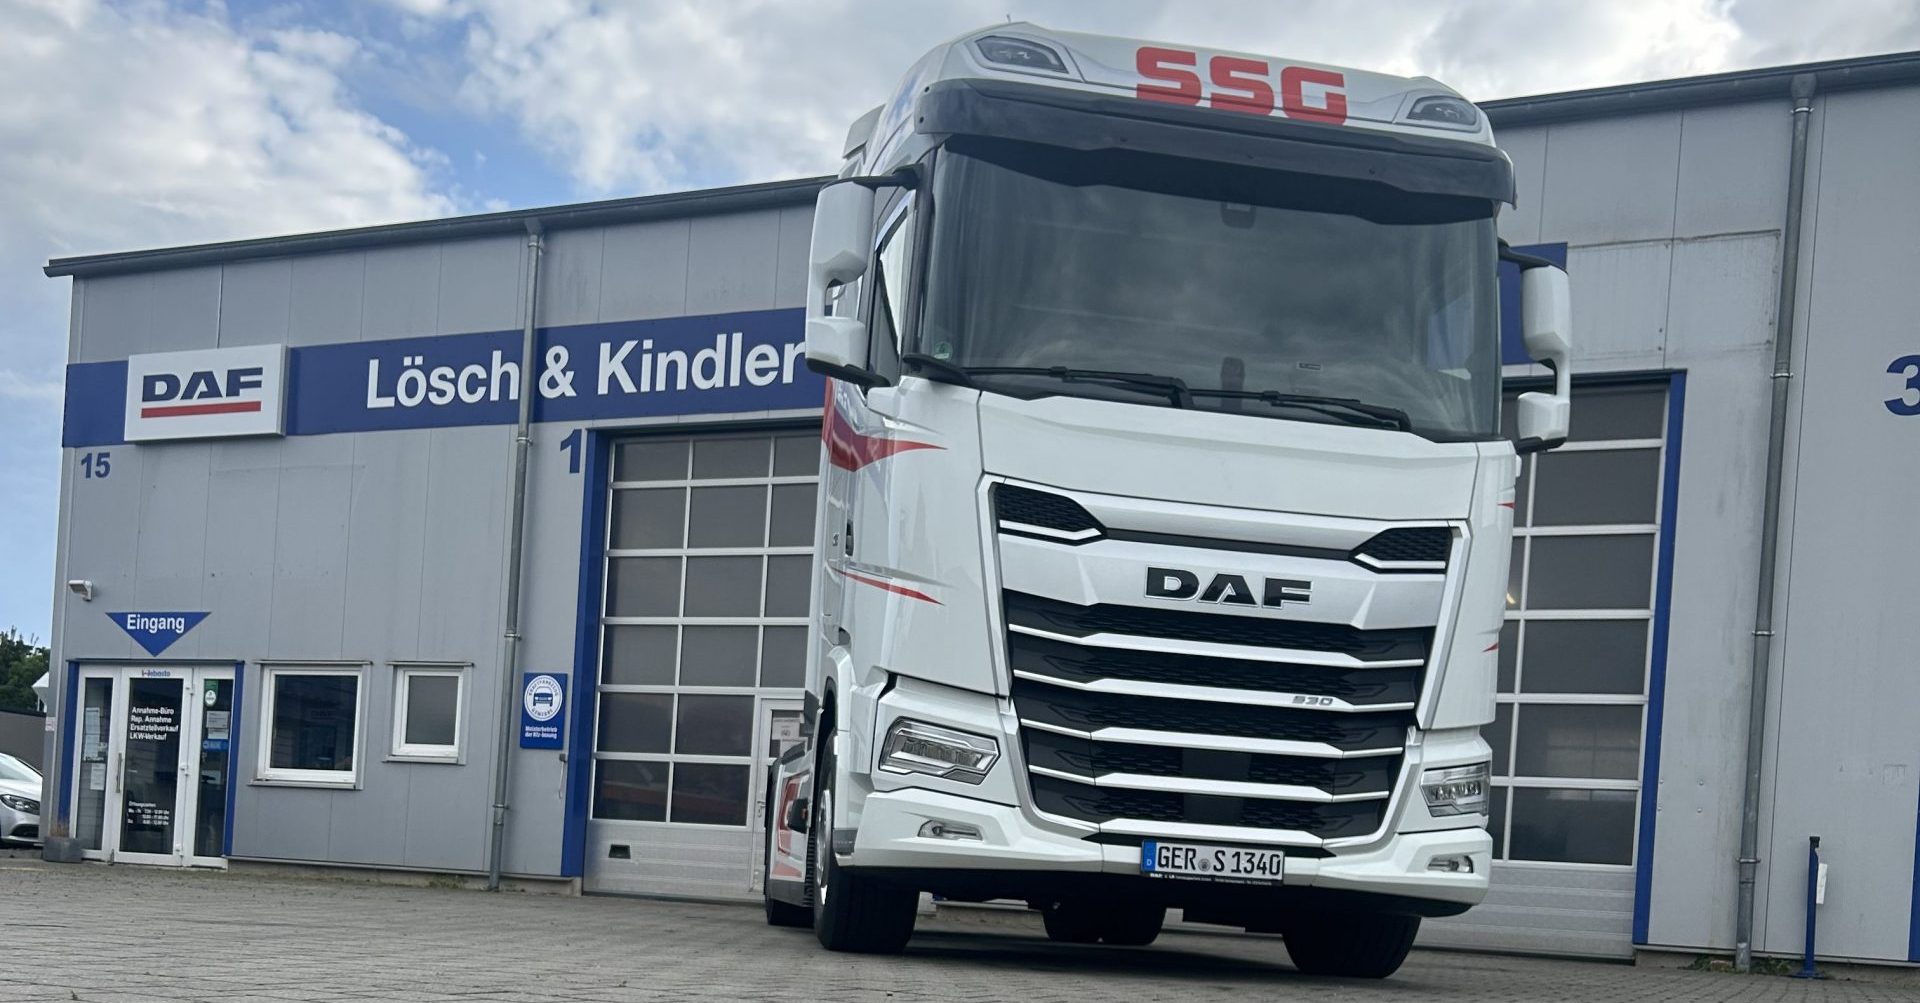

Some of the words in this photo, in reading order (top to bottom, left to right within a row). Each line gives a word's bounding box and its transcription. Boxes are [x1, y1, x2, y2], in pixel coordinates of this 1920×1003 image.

[1136, 46, 1347, 126] SSG
[142, 366, 263, 403] DAF
[366, 350, 521, 409] Lösch
[538, 345, 577, 399] &
[597, 332, 806, 395] Kindler
[1884, 354, 1920, 417] 3
[80, 451, 111, 479] 15
[560, 428, 582, 474] 1
[1144, 565, 1313, 610] DAF
[127, 613, 185, 634] Eingang
[1146, 858, 1153, 867] D
[1157, 845, 1197, 871] GER
[1213, 849, 1226, 873] S
[1231, 851, 1281, 876] 1340
